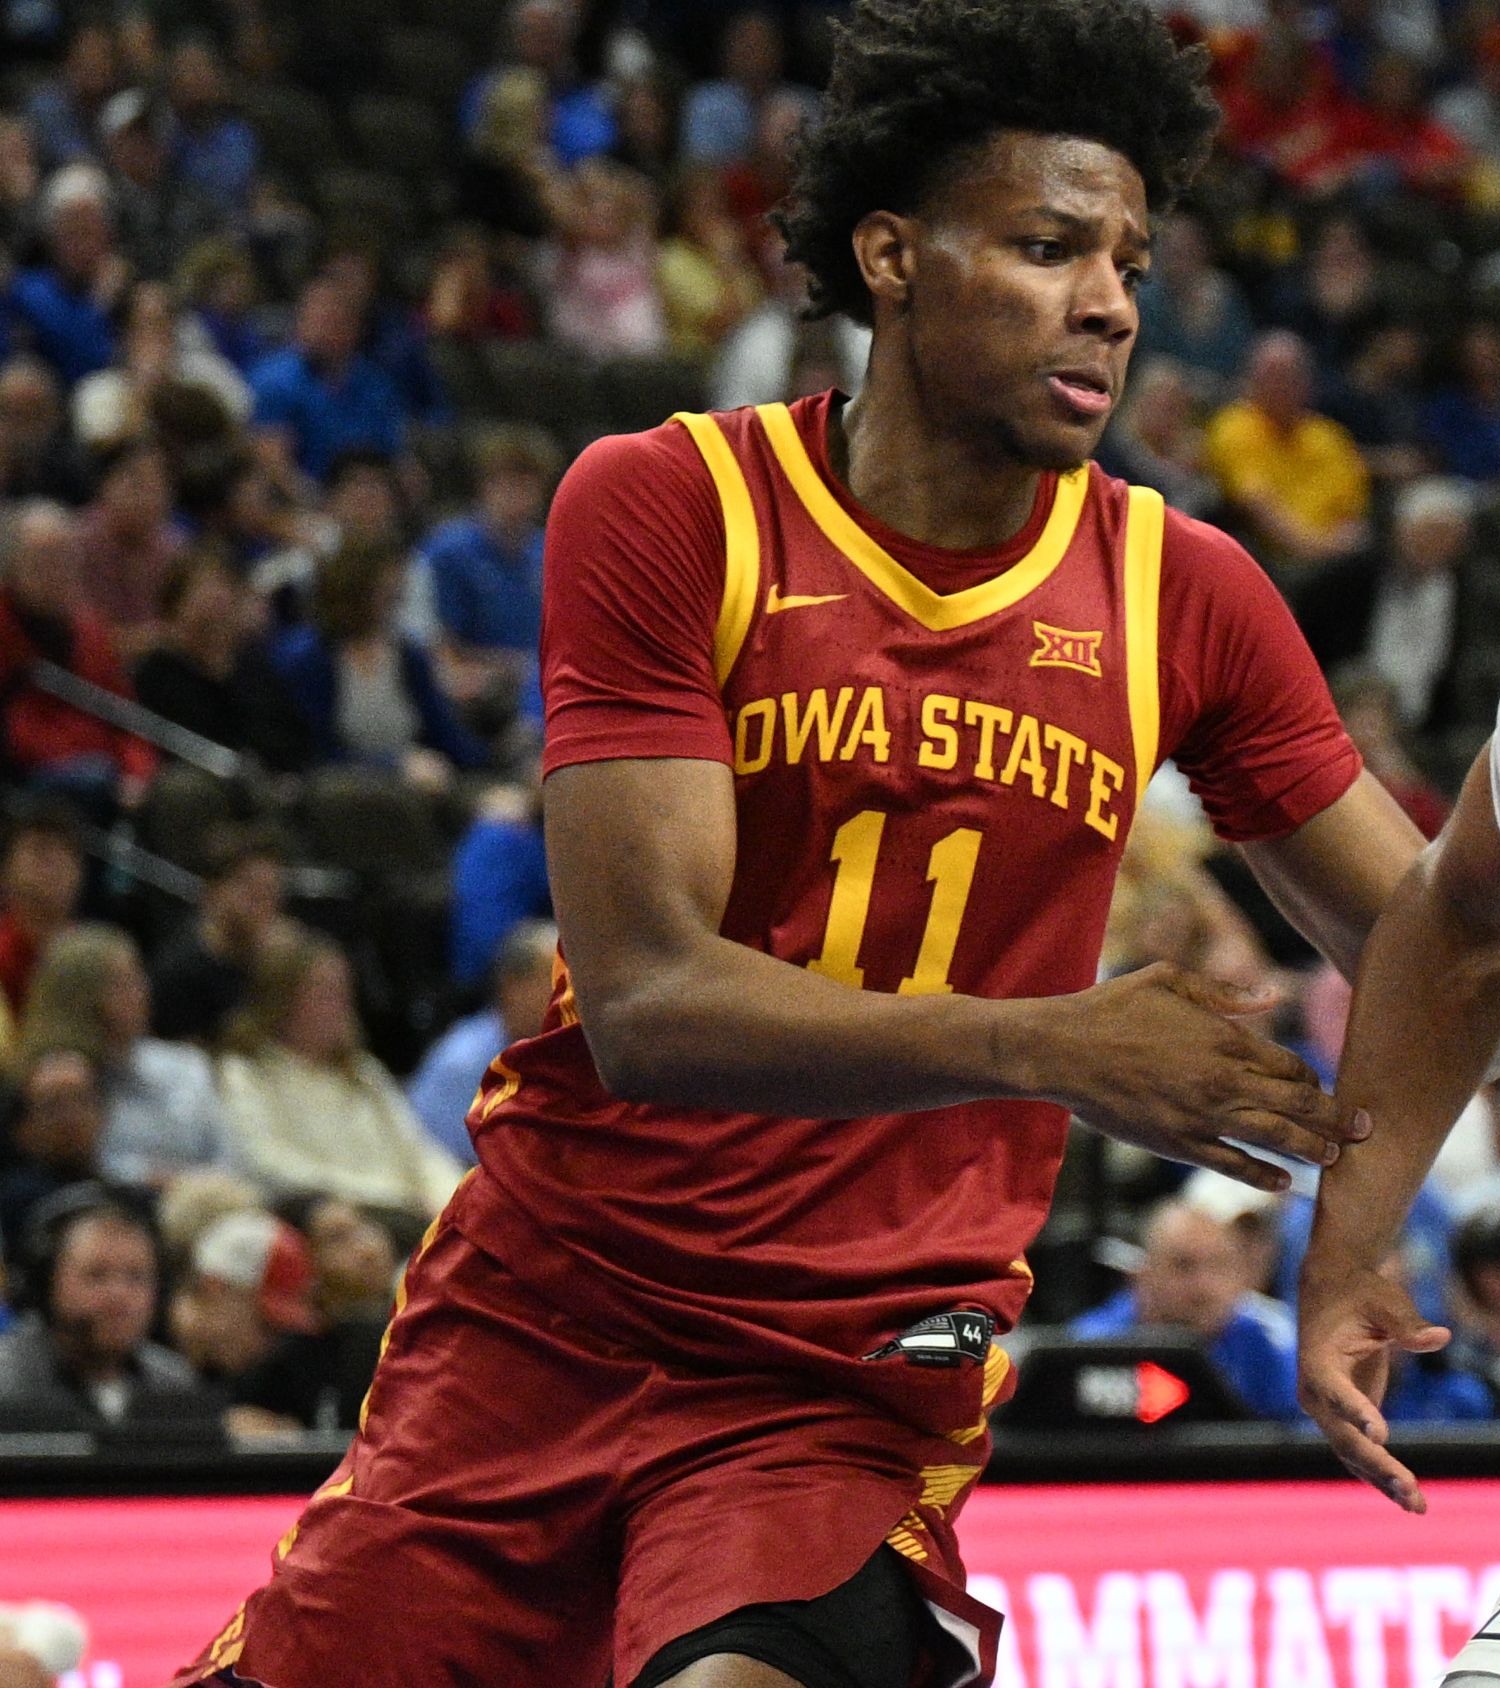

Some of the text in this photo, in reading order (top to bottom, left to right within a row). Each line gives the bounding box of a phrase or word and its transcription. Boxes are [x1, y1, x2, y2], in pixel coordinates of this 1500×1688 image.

[1036, 626, 1100, 671] XII
[735, 686, 1125, 841] OWA STATE
[805, 809, 983, 996] 11
[962, 1323, 983, 1345] 44
